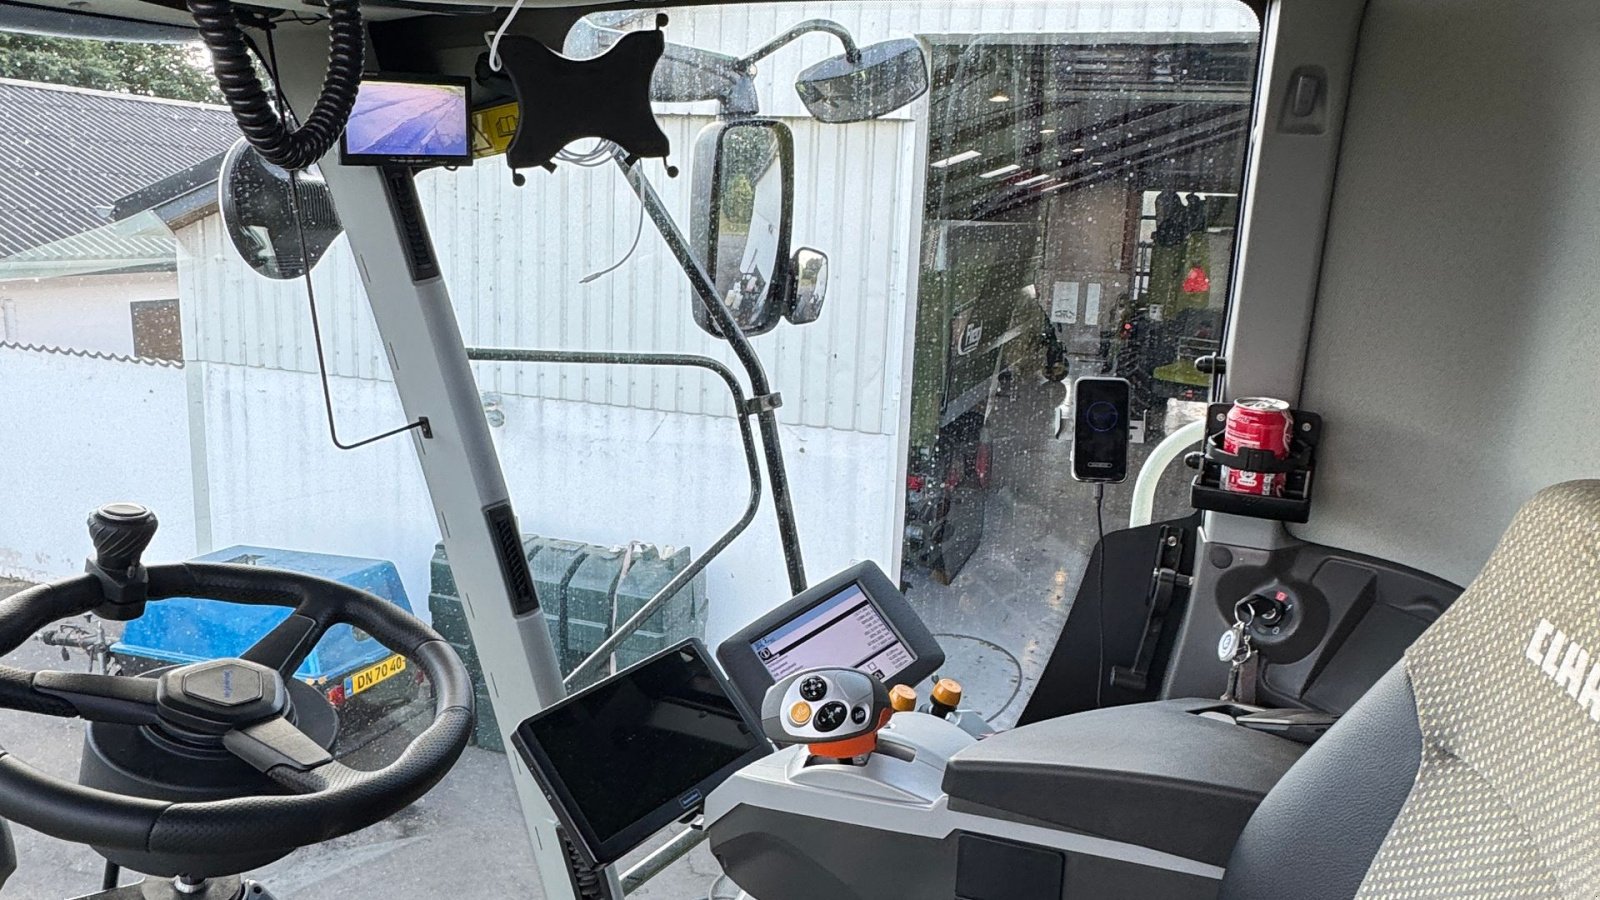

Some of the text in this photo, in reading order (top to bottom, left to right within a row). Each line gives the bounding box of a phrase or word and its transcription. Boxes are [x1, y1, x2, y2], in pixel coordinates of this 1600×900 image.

[357, 656, 402, 689] DN 70 40
